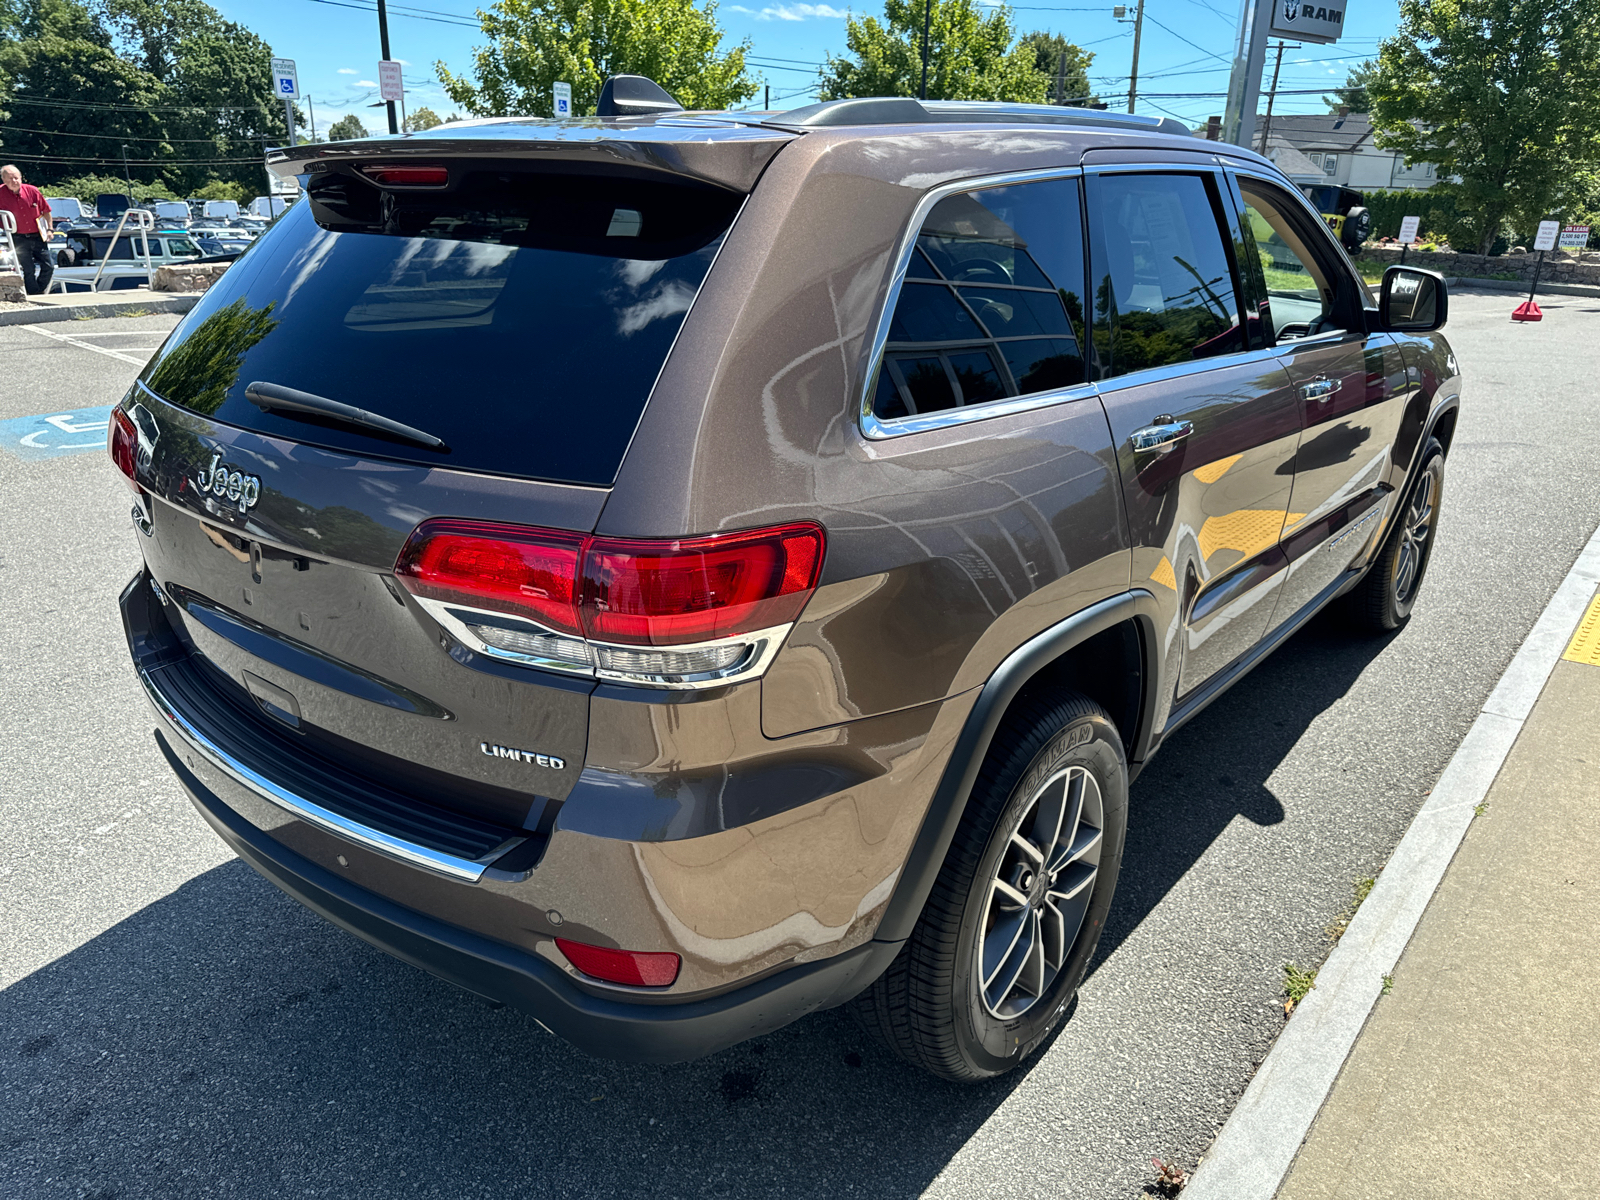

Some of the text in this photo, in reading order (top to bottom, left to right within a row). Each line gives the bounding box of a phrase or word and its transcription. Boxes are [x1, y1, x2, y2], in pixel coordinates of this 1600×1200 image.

[1302, 4, 1342, 24] RAM
[197, 453, 262, 514] Jeep
[480, 742, 566, 769] LIMITED
[1004, 722, 1093, 834] IRONMAN
